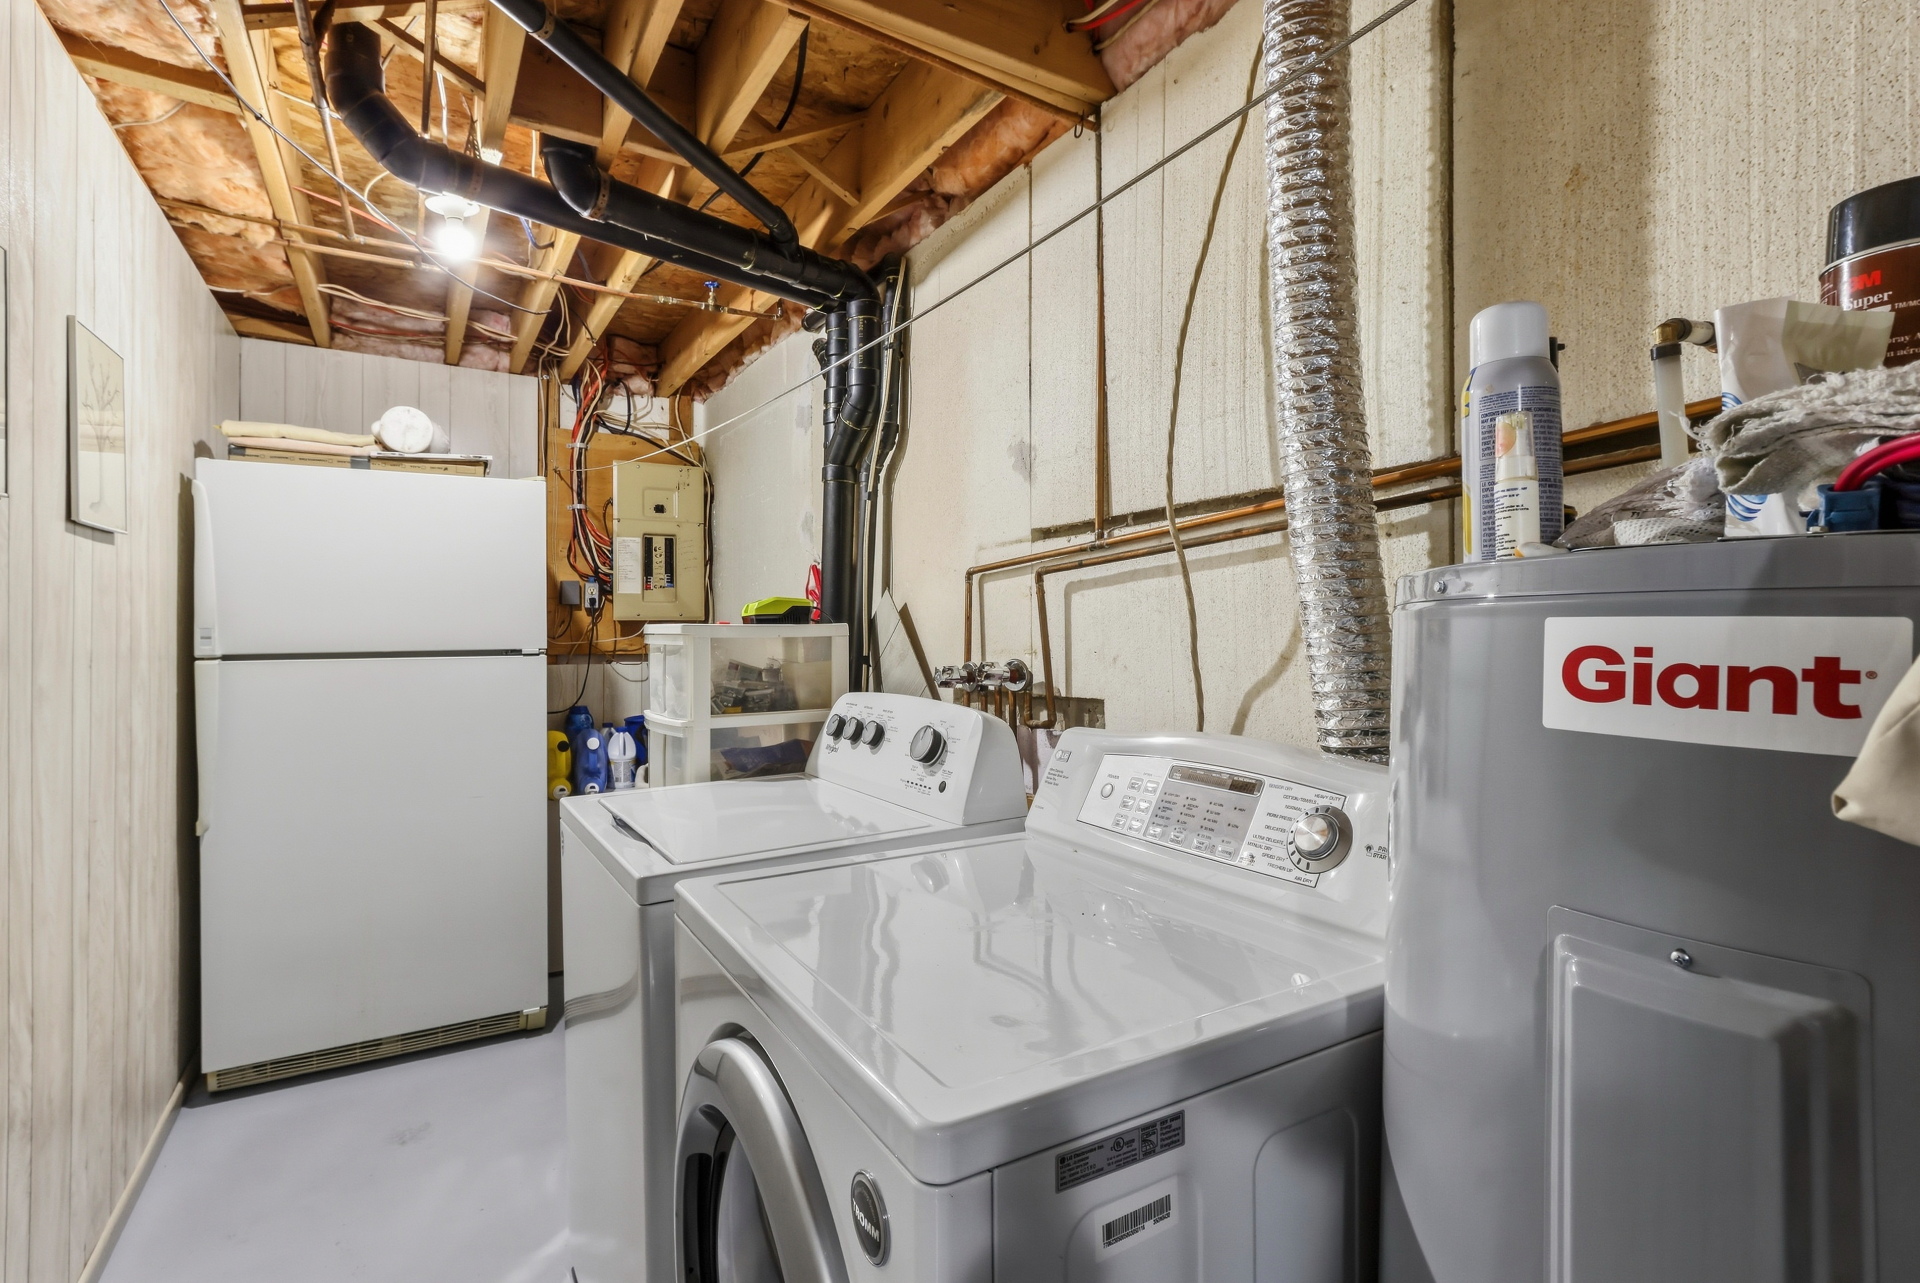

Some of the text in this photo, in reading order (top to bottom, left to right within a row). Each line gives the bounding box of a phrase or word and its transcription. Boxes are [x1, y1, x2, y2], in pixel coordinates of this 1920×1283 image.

[1849, 270, 1882, 293] 3M
[1845, 291, 1893, 310] Super
[1562, 645, 1862, 719] Giant
[1264, 824, 1286, 833] DELICATES
[853, 1198, 880, 1242] TROMM
